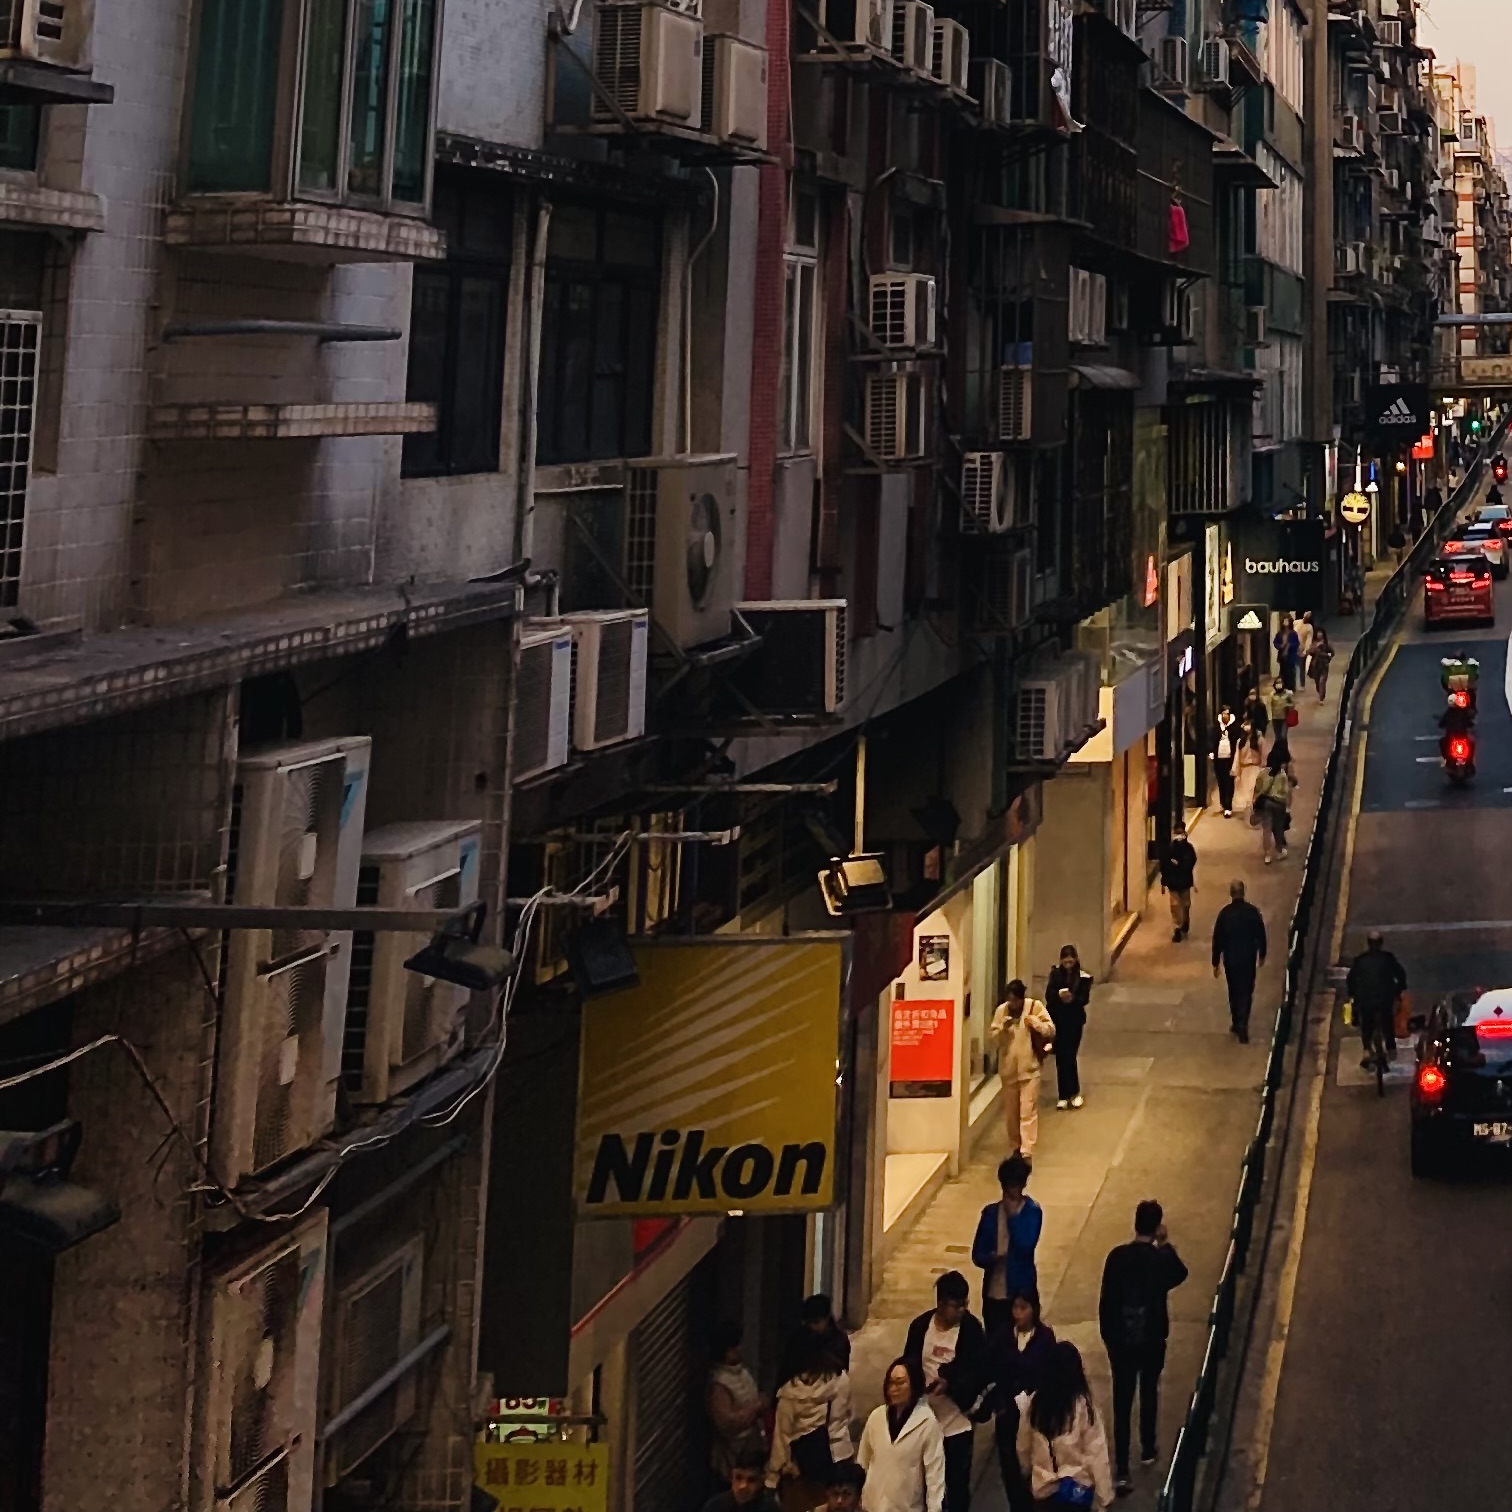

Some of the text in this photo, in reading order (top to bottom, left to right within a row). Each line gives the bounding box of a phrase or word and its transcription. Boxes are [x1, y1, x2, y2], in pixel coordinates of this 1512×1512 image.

[1378, 413, 1417, 425] adidas
[1244, 557, 1320, 574] bauhaus
[586, 1129, 826, 1205] Nikon
[485, 1456, 599, 1487] 攝影器材
